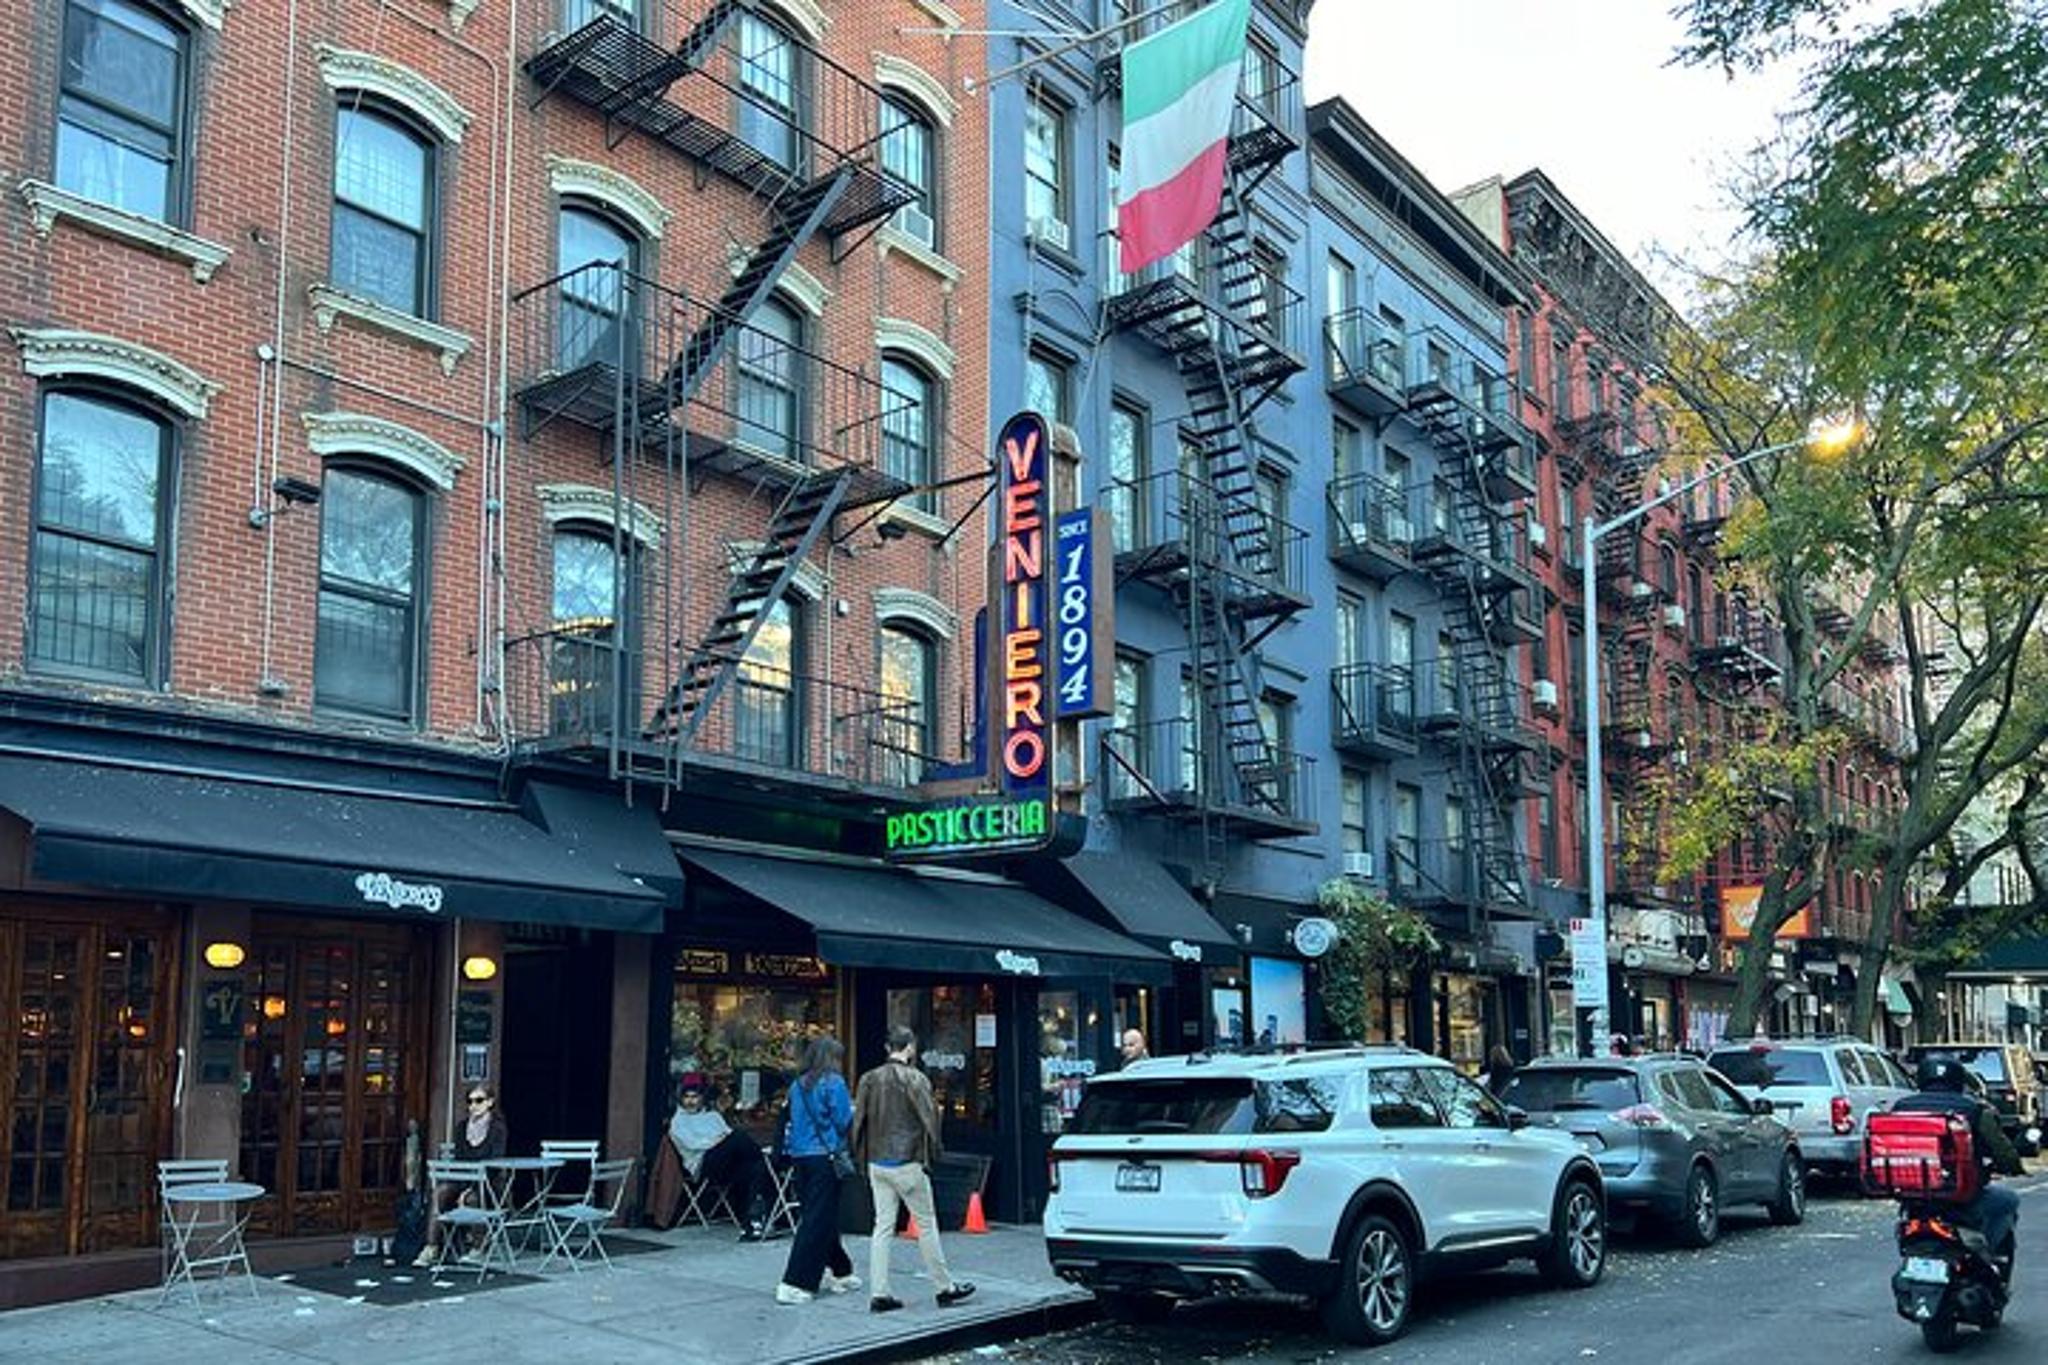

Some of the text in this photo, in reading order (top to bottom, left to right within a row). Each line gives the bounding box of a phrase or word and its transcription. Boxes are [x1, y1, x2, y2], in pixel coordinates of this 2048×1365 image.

[1003, 430, 1046, 778] VENIERO
[1060, 543, 1088, 702] 1894
[887, 801, 1046, 849] PASTICCERIA
